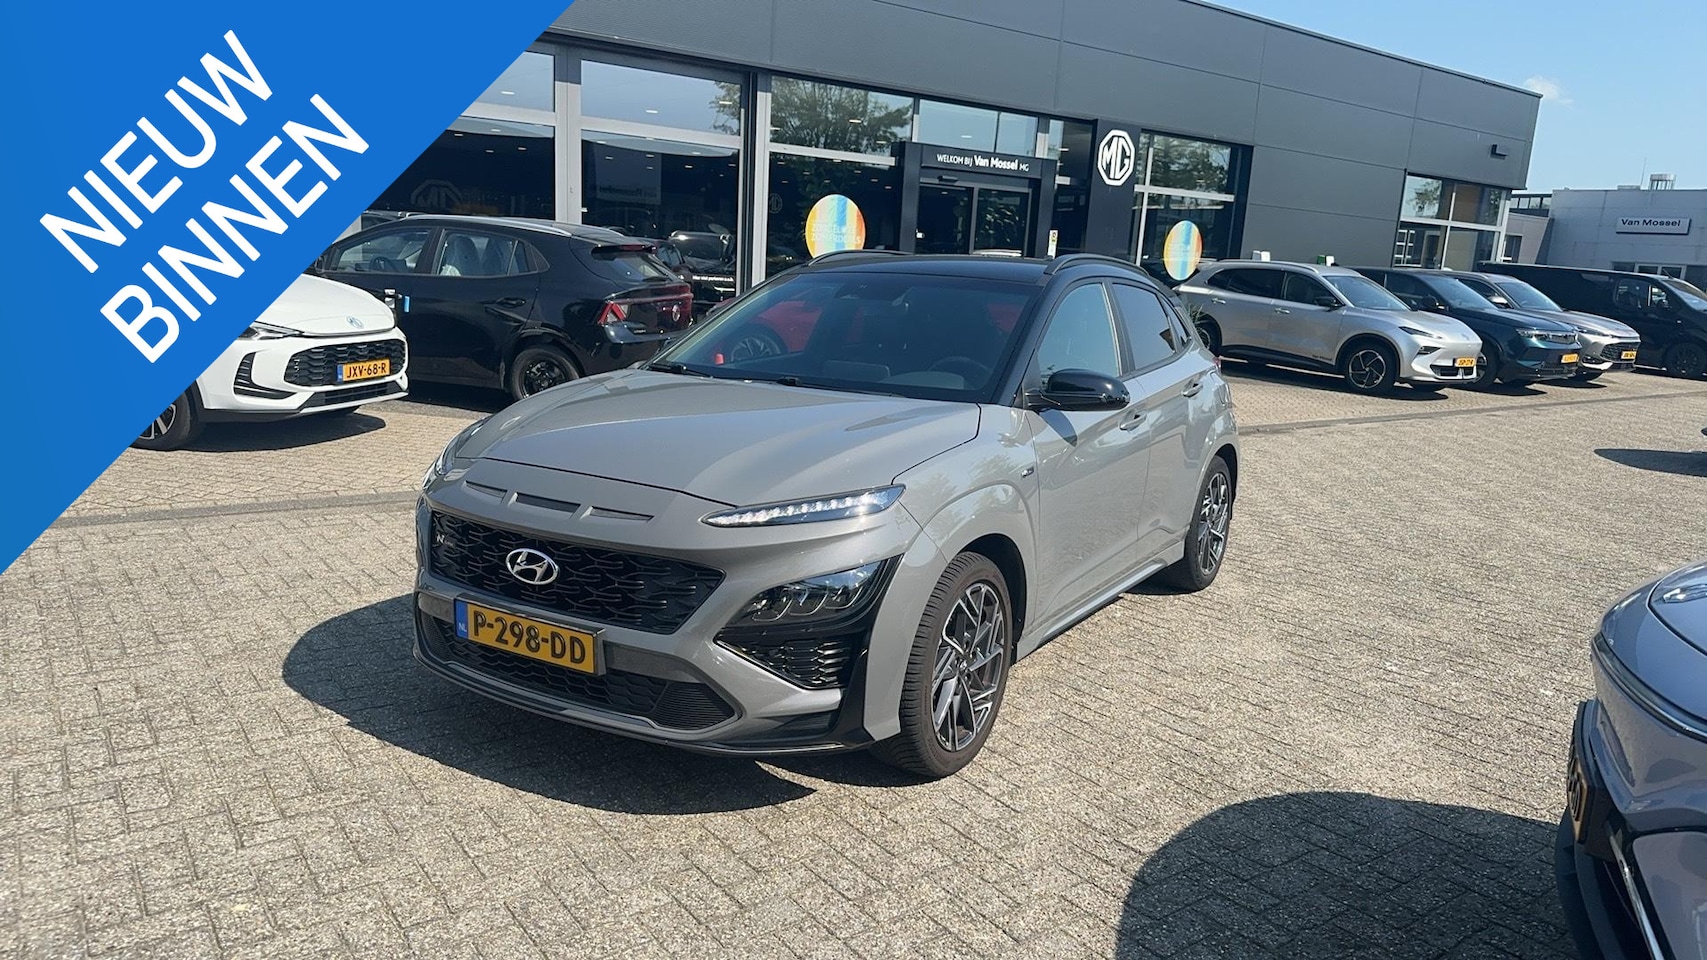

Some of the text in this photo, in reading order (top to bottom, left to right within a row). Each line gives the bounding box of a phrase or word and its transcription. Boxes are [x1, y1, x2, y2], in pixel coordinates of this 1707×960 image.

[937, 153, 1030, 172] WELKOM BIJ Van Mossel MG
[1101, 135, 1132, 180] MG
[1621, 218, 1681, 227] Van Mossel
[346, 362, 387, 379] JXV-68-R
[458, 623, 467, 632] NL
[473, 610, 586, 664] P-298-DD
